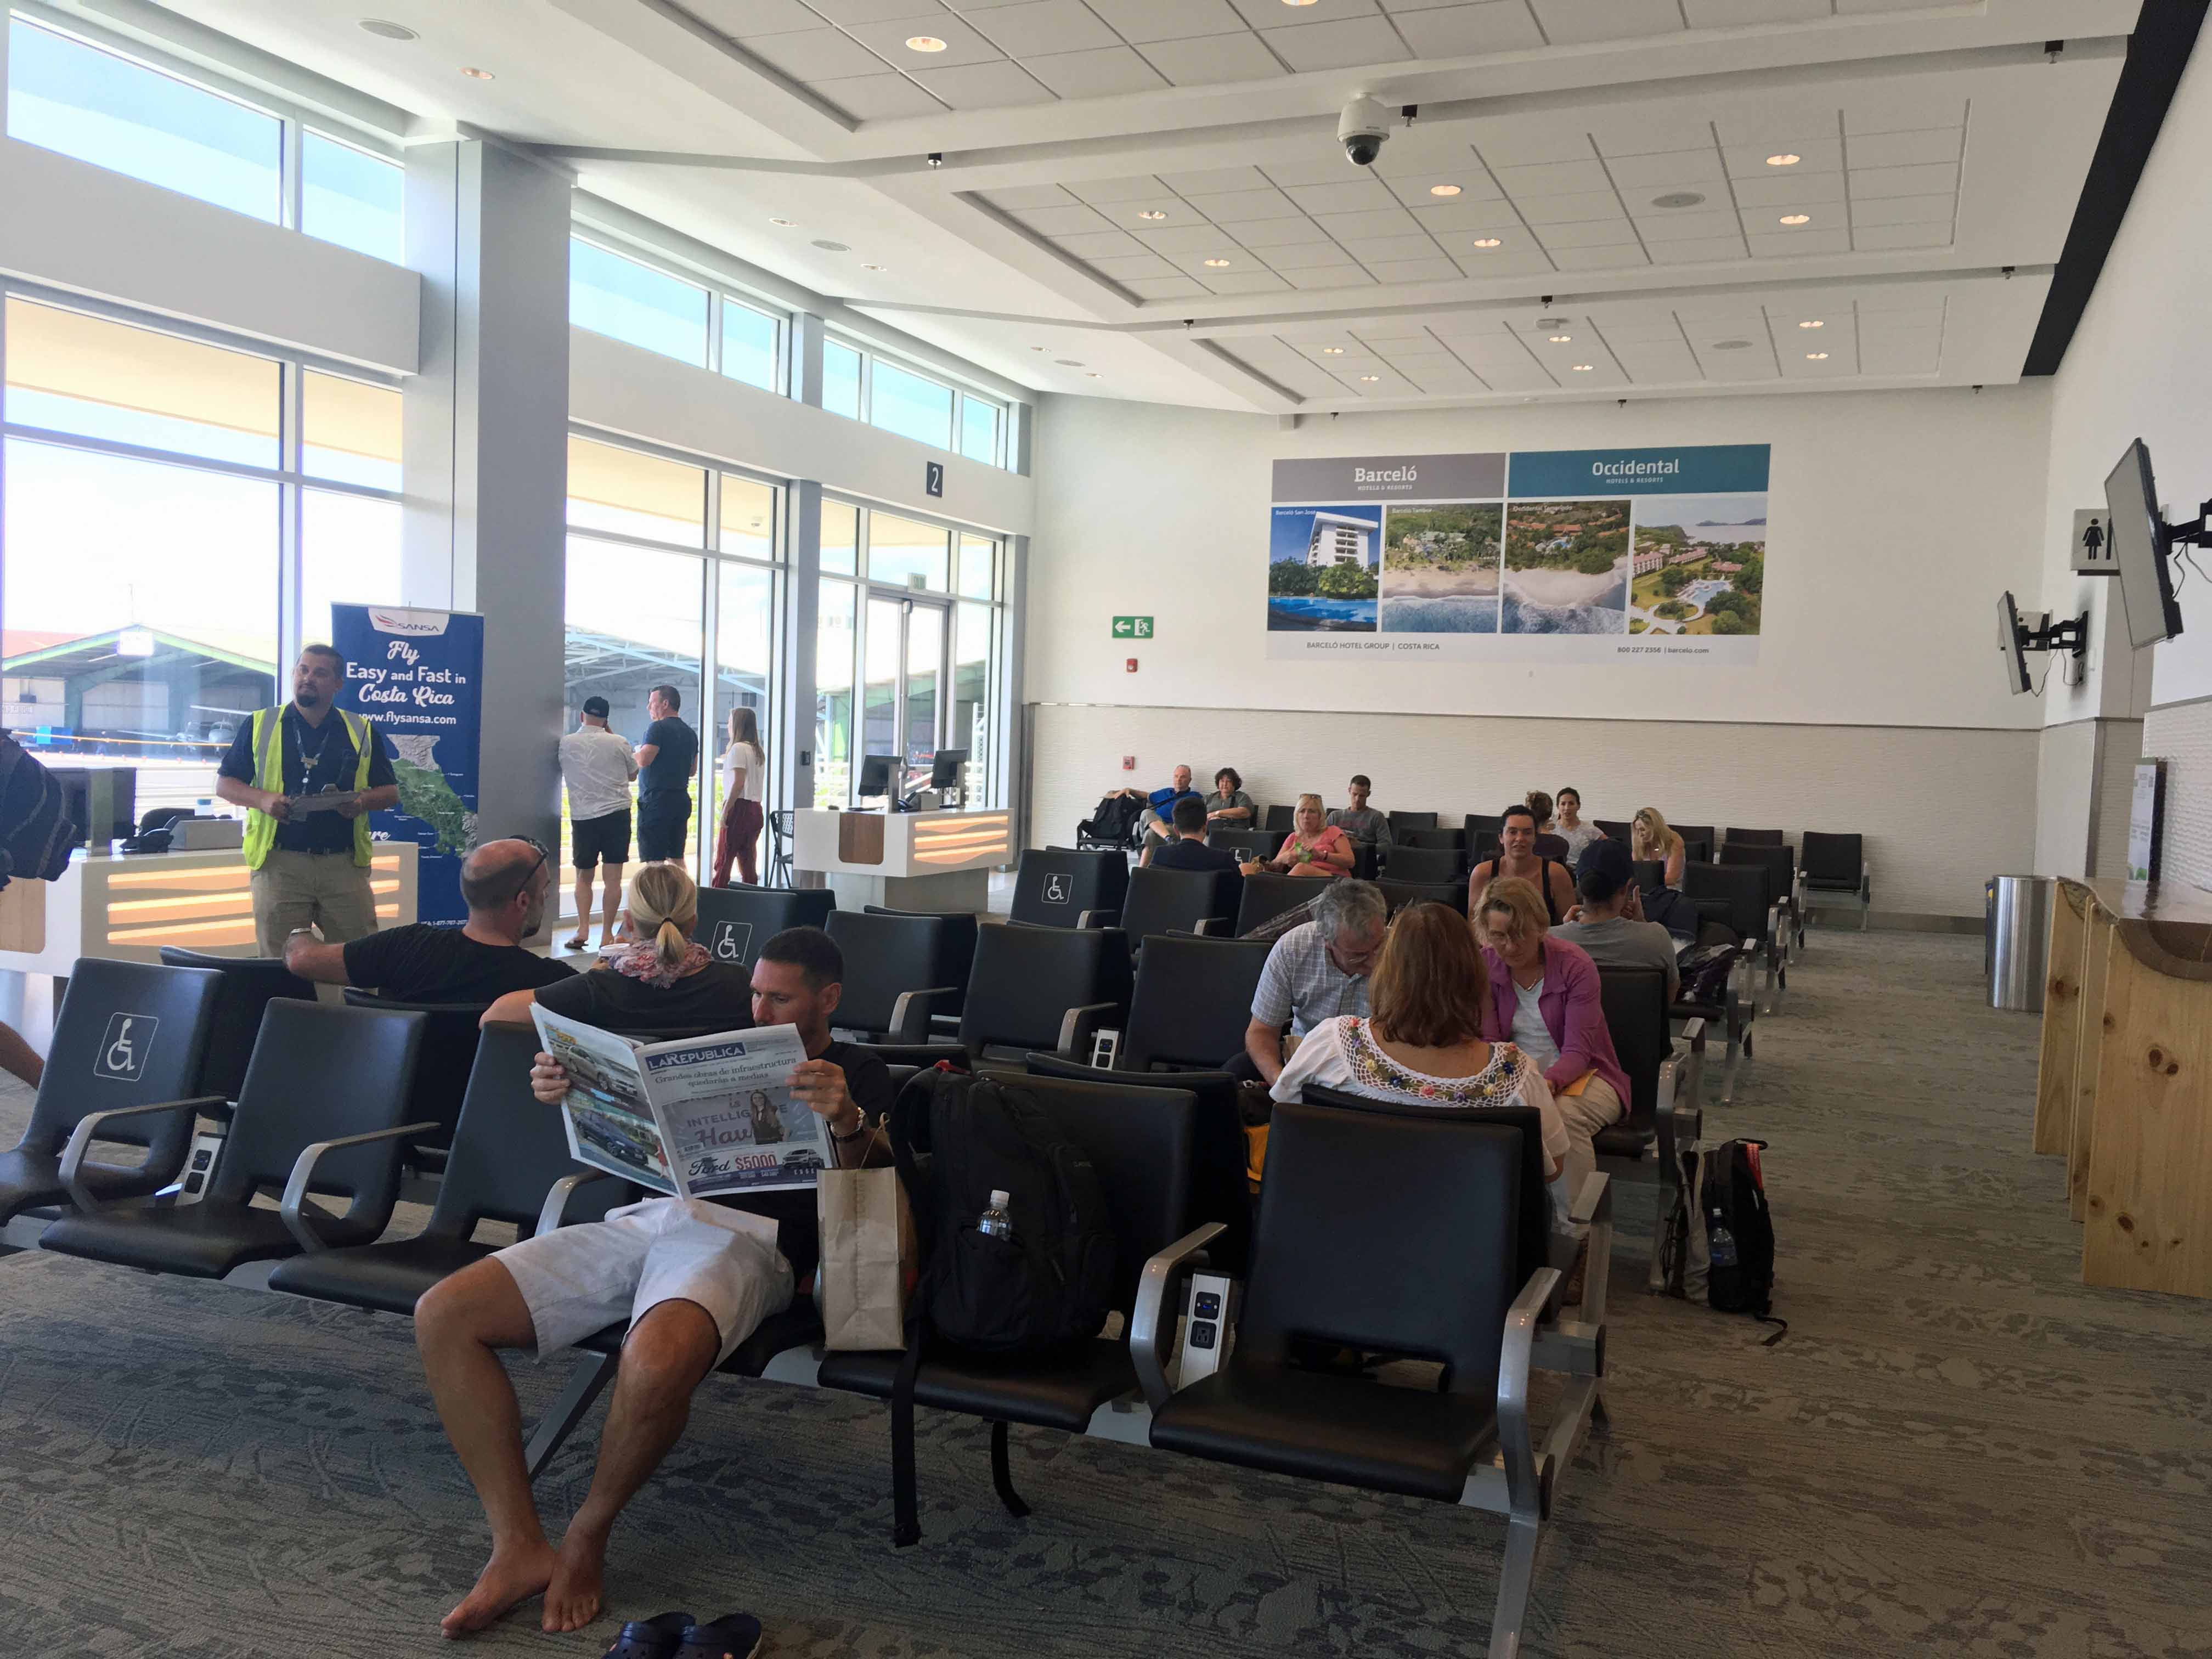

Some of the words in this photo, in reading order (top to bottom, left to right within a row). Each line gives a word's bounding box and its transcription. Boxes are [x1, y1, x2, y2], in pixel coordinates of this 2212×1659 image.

[1354, 465, 1418, 482] Barceló
[1593, 458, 1680, 476] Occidental
[932, 467, 939, 493] 2
[397, 623, 439, 631] SANSA
[387, 641, 420, 665] Fly
[346, 662, 387, 684] Easy
[391, 670, 413, 681] and
[418, 666, 452, 684] Fast
[455, 674, 466, 684] in
[359, 683, 408, 703] Costa
[413, 686, 455, 707] Rica
[654, 1072, 692, 1085] Grandes
[693, 1069, 718, 1079] obras
[731, 1057, 797, 1074] infraestructura
[738, 1072, 768, 1081] medias
[689, 1156, 730, 1176] Ford
[735, 1154, 777, 1171] $5000
